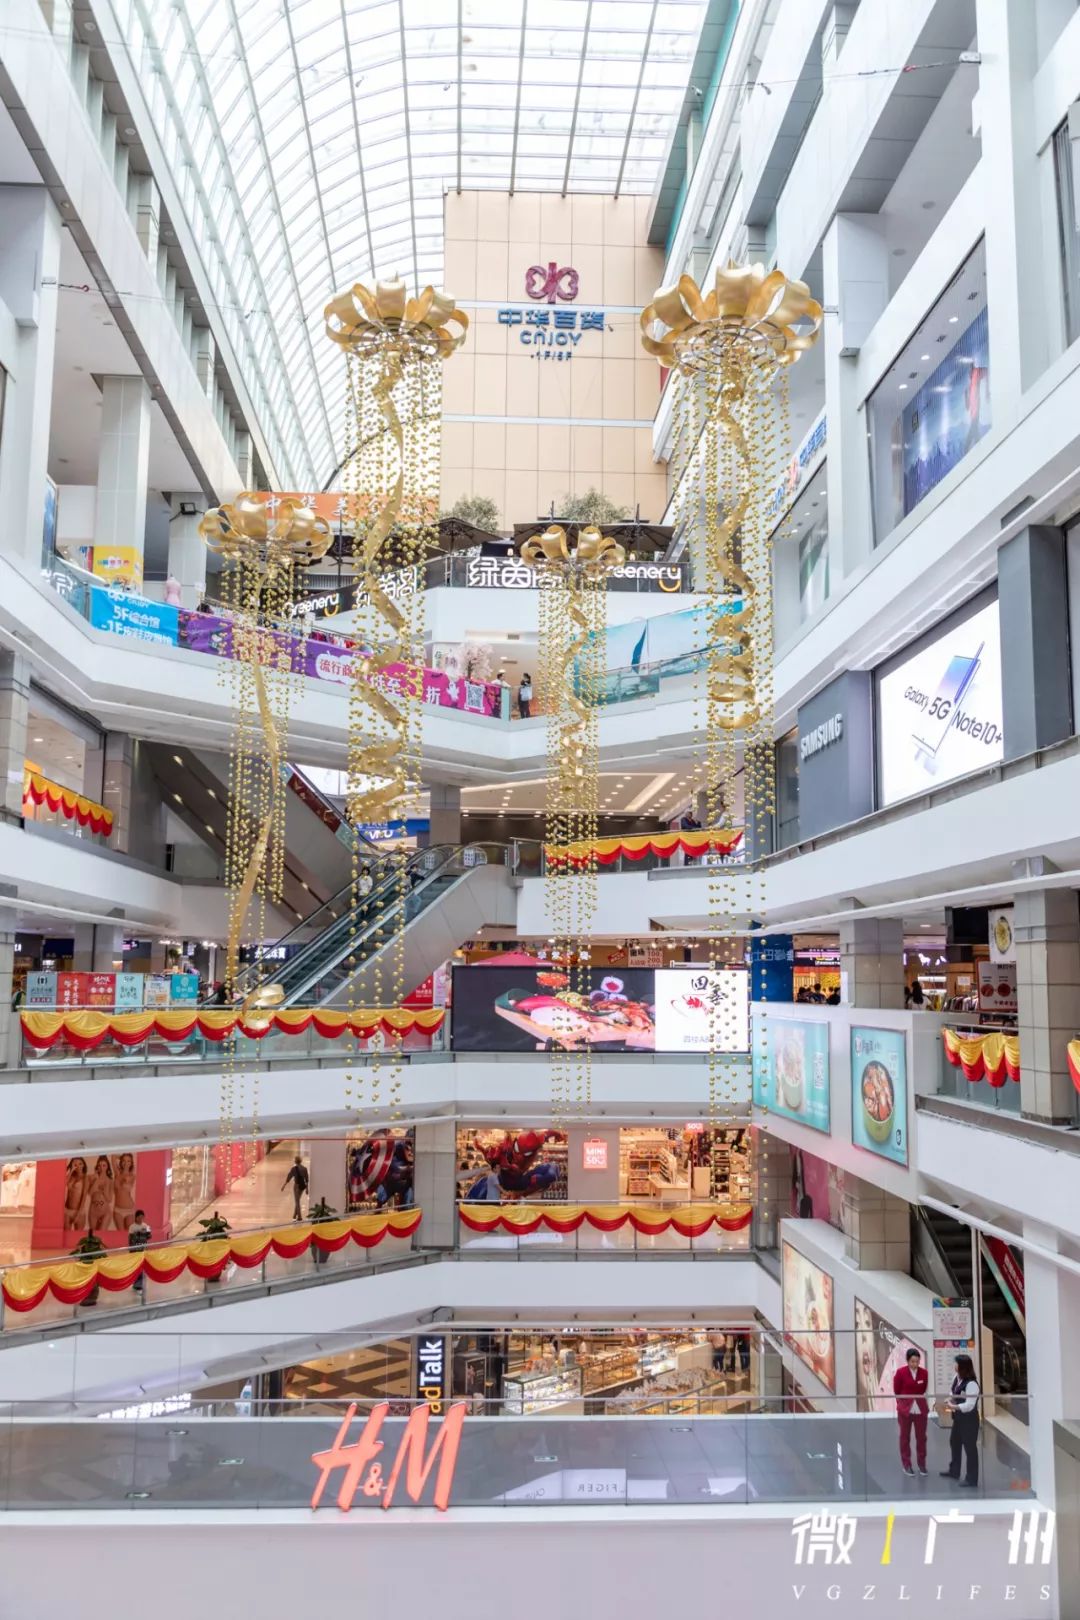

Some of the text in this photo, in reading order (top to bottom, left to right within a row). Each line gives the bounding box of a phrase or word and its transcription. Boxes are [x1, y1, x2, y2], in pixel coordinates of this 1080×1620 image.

[498, 309, 604, 330] 中华百货
[801, 713, 844, 761] SAMSUNG
[904, 686, 1003, 746] Galaxy 5G Note10+
[310, 1401, 469, 1512] H&M
